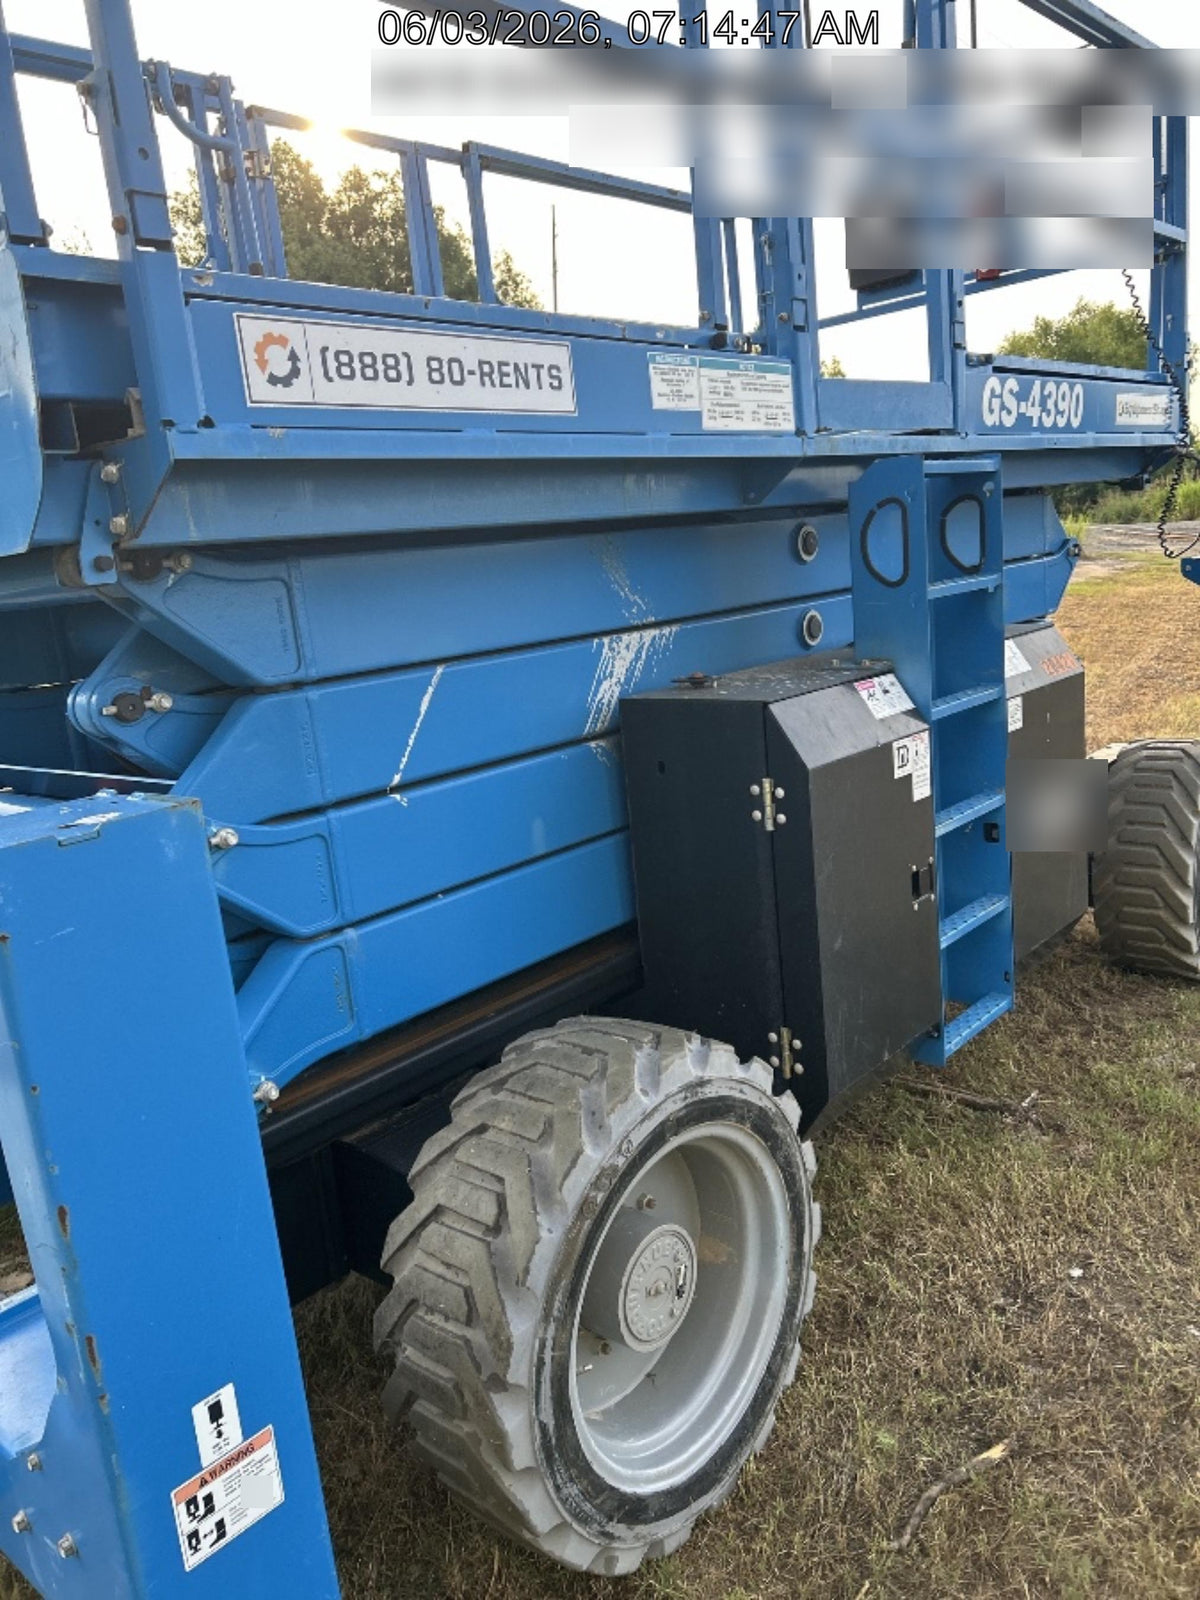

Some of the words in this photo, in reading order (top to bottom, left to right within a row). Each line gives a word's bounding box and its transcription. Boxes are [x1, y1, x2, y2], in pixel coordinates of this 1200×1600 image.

[319, 345, 415, 387] (888)
[426, 355, 563, 391] 80-RENTS
[982, 376, 1084, 428] GS-4390
[208, 1442, 255, 1481] WARNING
